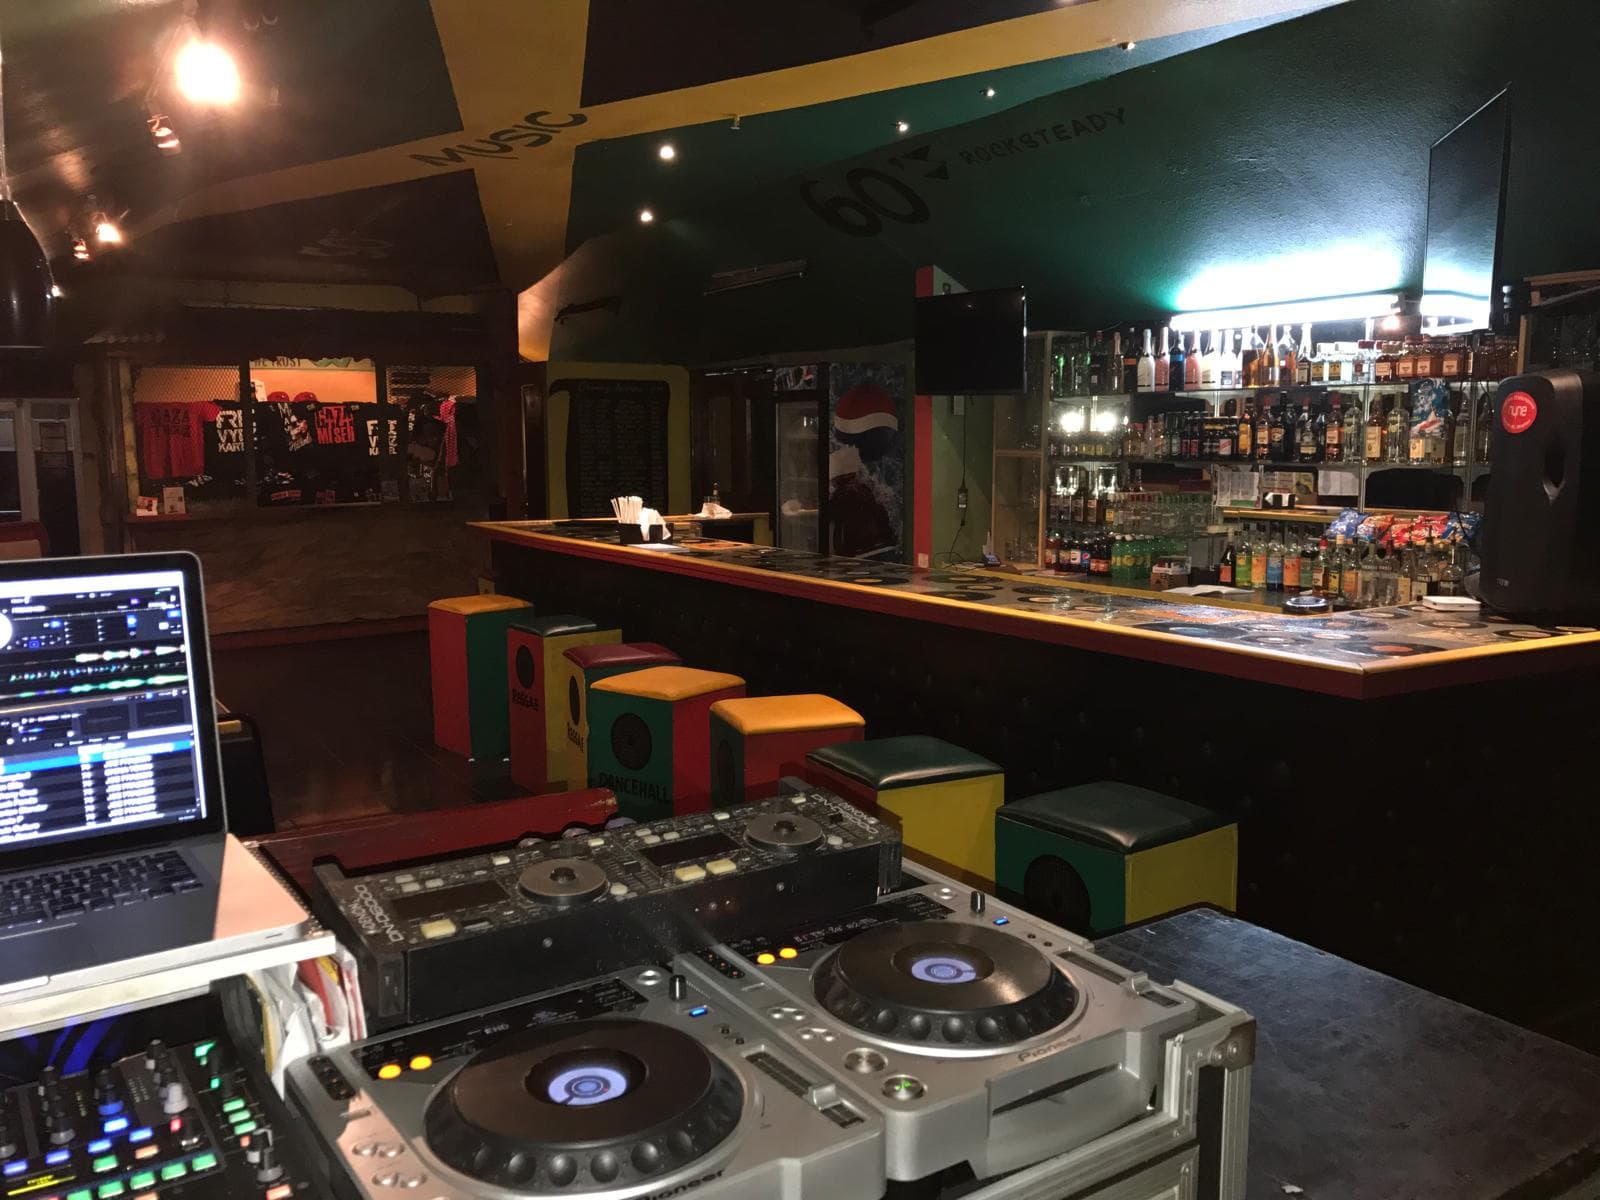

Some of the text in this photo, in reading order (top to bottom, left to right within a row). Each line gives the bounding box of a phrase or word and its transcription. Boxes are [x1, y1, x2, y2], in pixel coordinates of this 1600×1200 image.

[408, 110, 588, 167] MUSIC
[958, 106, 1127, 166] ROCKSTEADY
[599, 772, 672, 804] DANCEHALL
[1018, 1034, 1082, 1062] Pioneer
